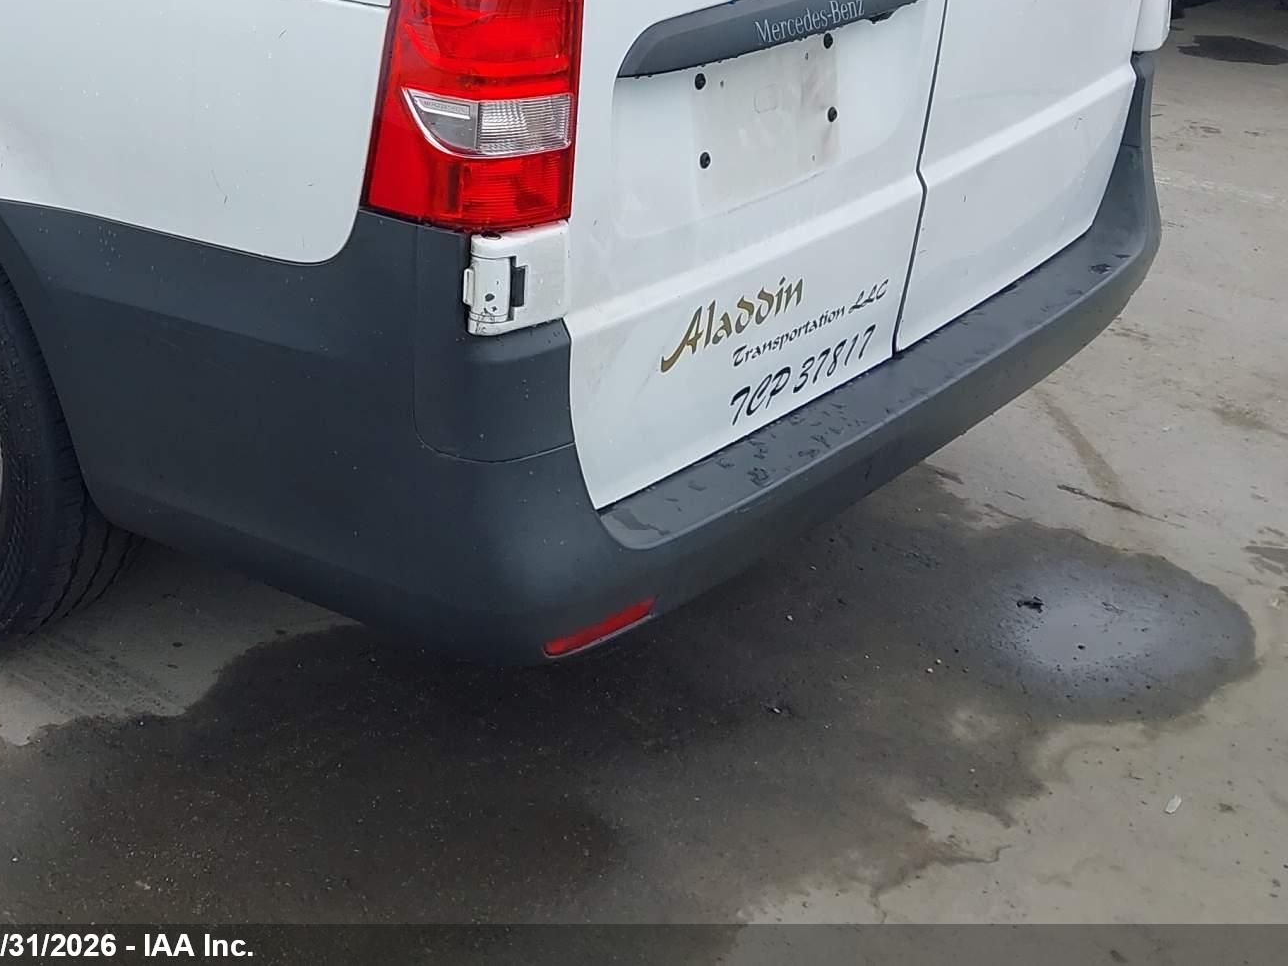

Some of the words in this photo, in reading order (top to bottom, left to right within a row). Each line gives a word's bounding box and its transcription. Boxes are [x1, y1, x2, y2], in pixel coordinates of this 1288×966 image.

[755, 0, 865, 43] Mercedes-Benz
[660, 276, 804, 373] Aladdin
[732, 305, 846, 367] Transportation
[848, 279, 889, 314] LLC
[793, 324, 876, 394] 37817
